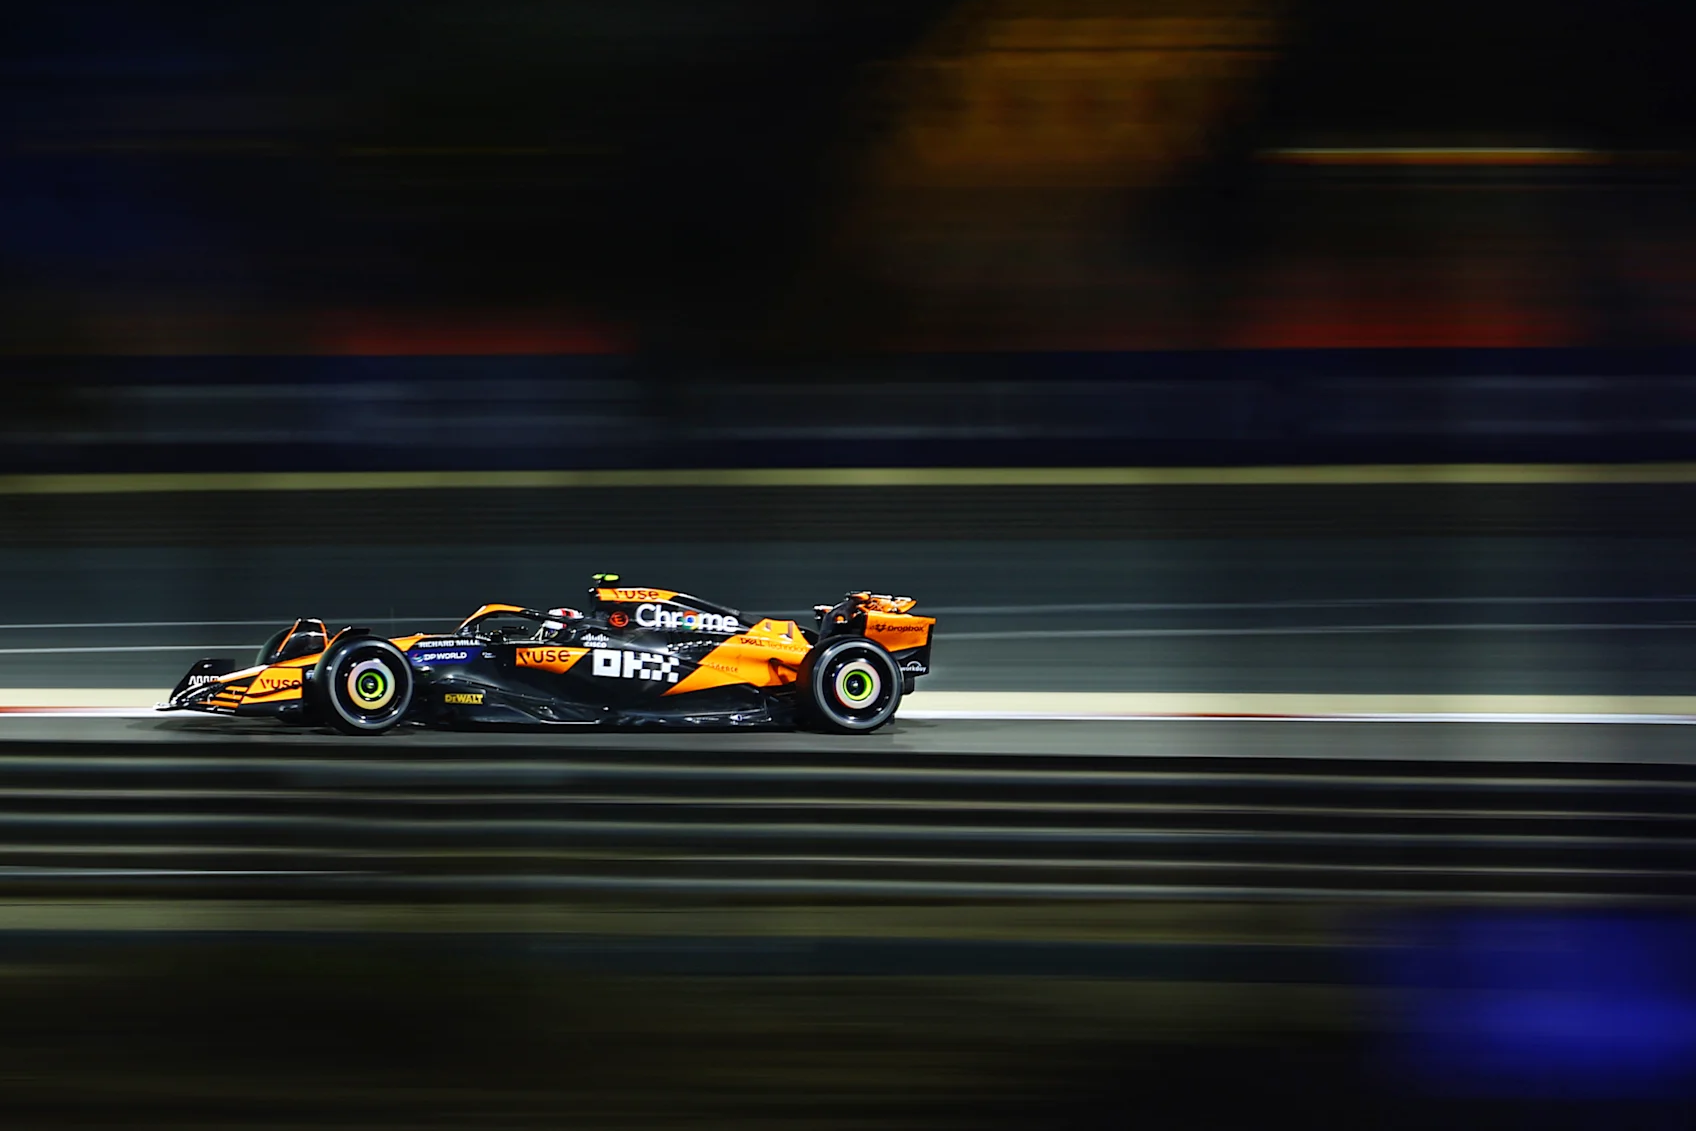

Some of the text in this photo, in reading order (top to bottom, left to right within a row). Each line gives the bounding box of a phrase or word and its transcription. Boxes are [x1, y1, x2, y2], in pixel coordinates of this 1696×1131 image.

[635, 603, 739, 632] Chrome
[887, 624, 924, 633] Dropbox
[418, 639, 455, 648] RICHARD
[423, 652, 467, 661] DP WORLD
[592, 648, 679, 683] OKX
